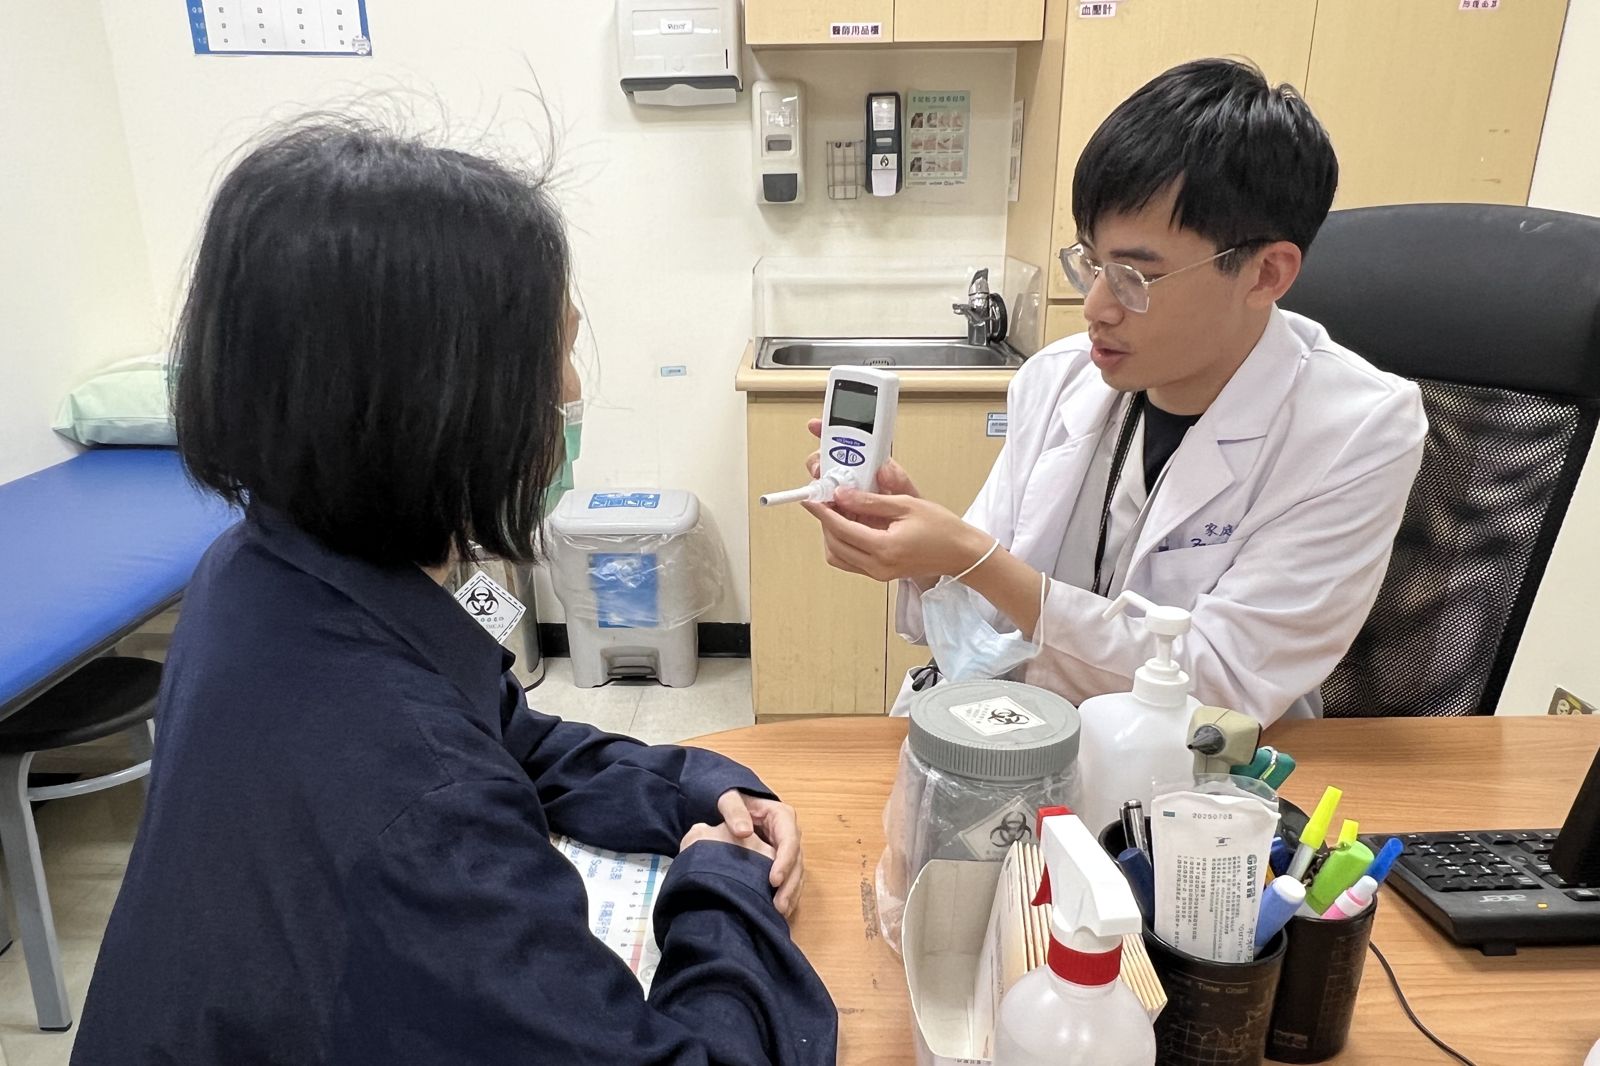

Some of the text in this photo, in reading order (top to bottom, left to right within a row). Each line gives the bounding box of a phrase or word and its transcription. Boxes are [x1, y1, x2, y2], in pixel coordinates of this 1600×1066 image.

[1081, 4, 1112, 16] 血壓計
[832, 25, 879, 36] 醫師用品櫃
[1205, 523, 1232, 536] 家庭
[1479, 894, 1526, 903] acer
